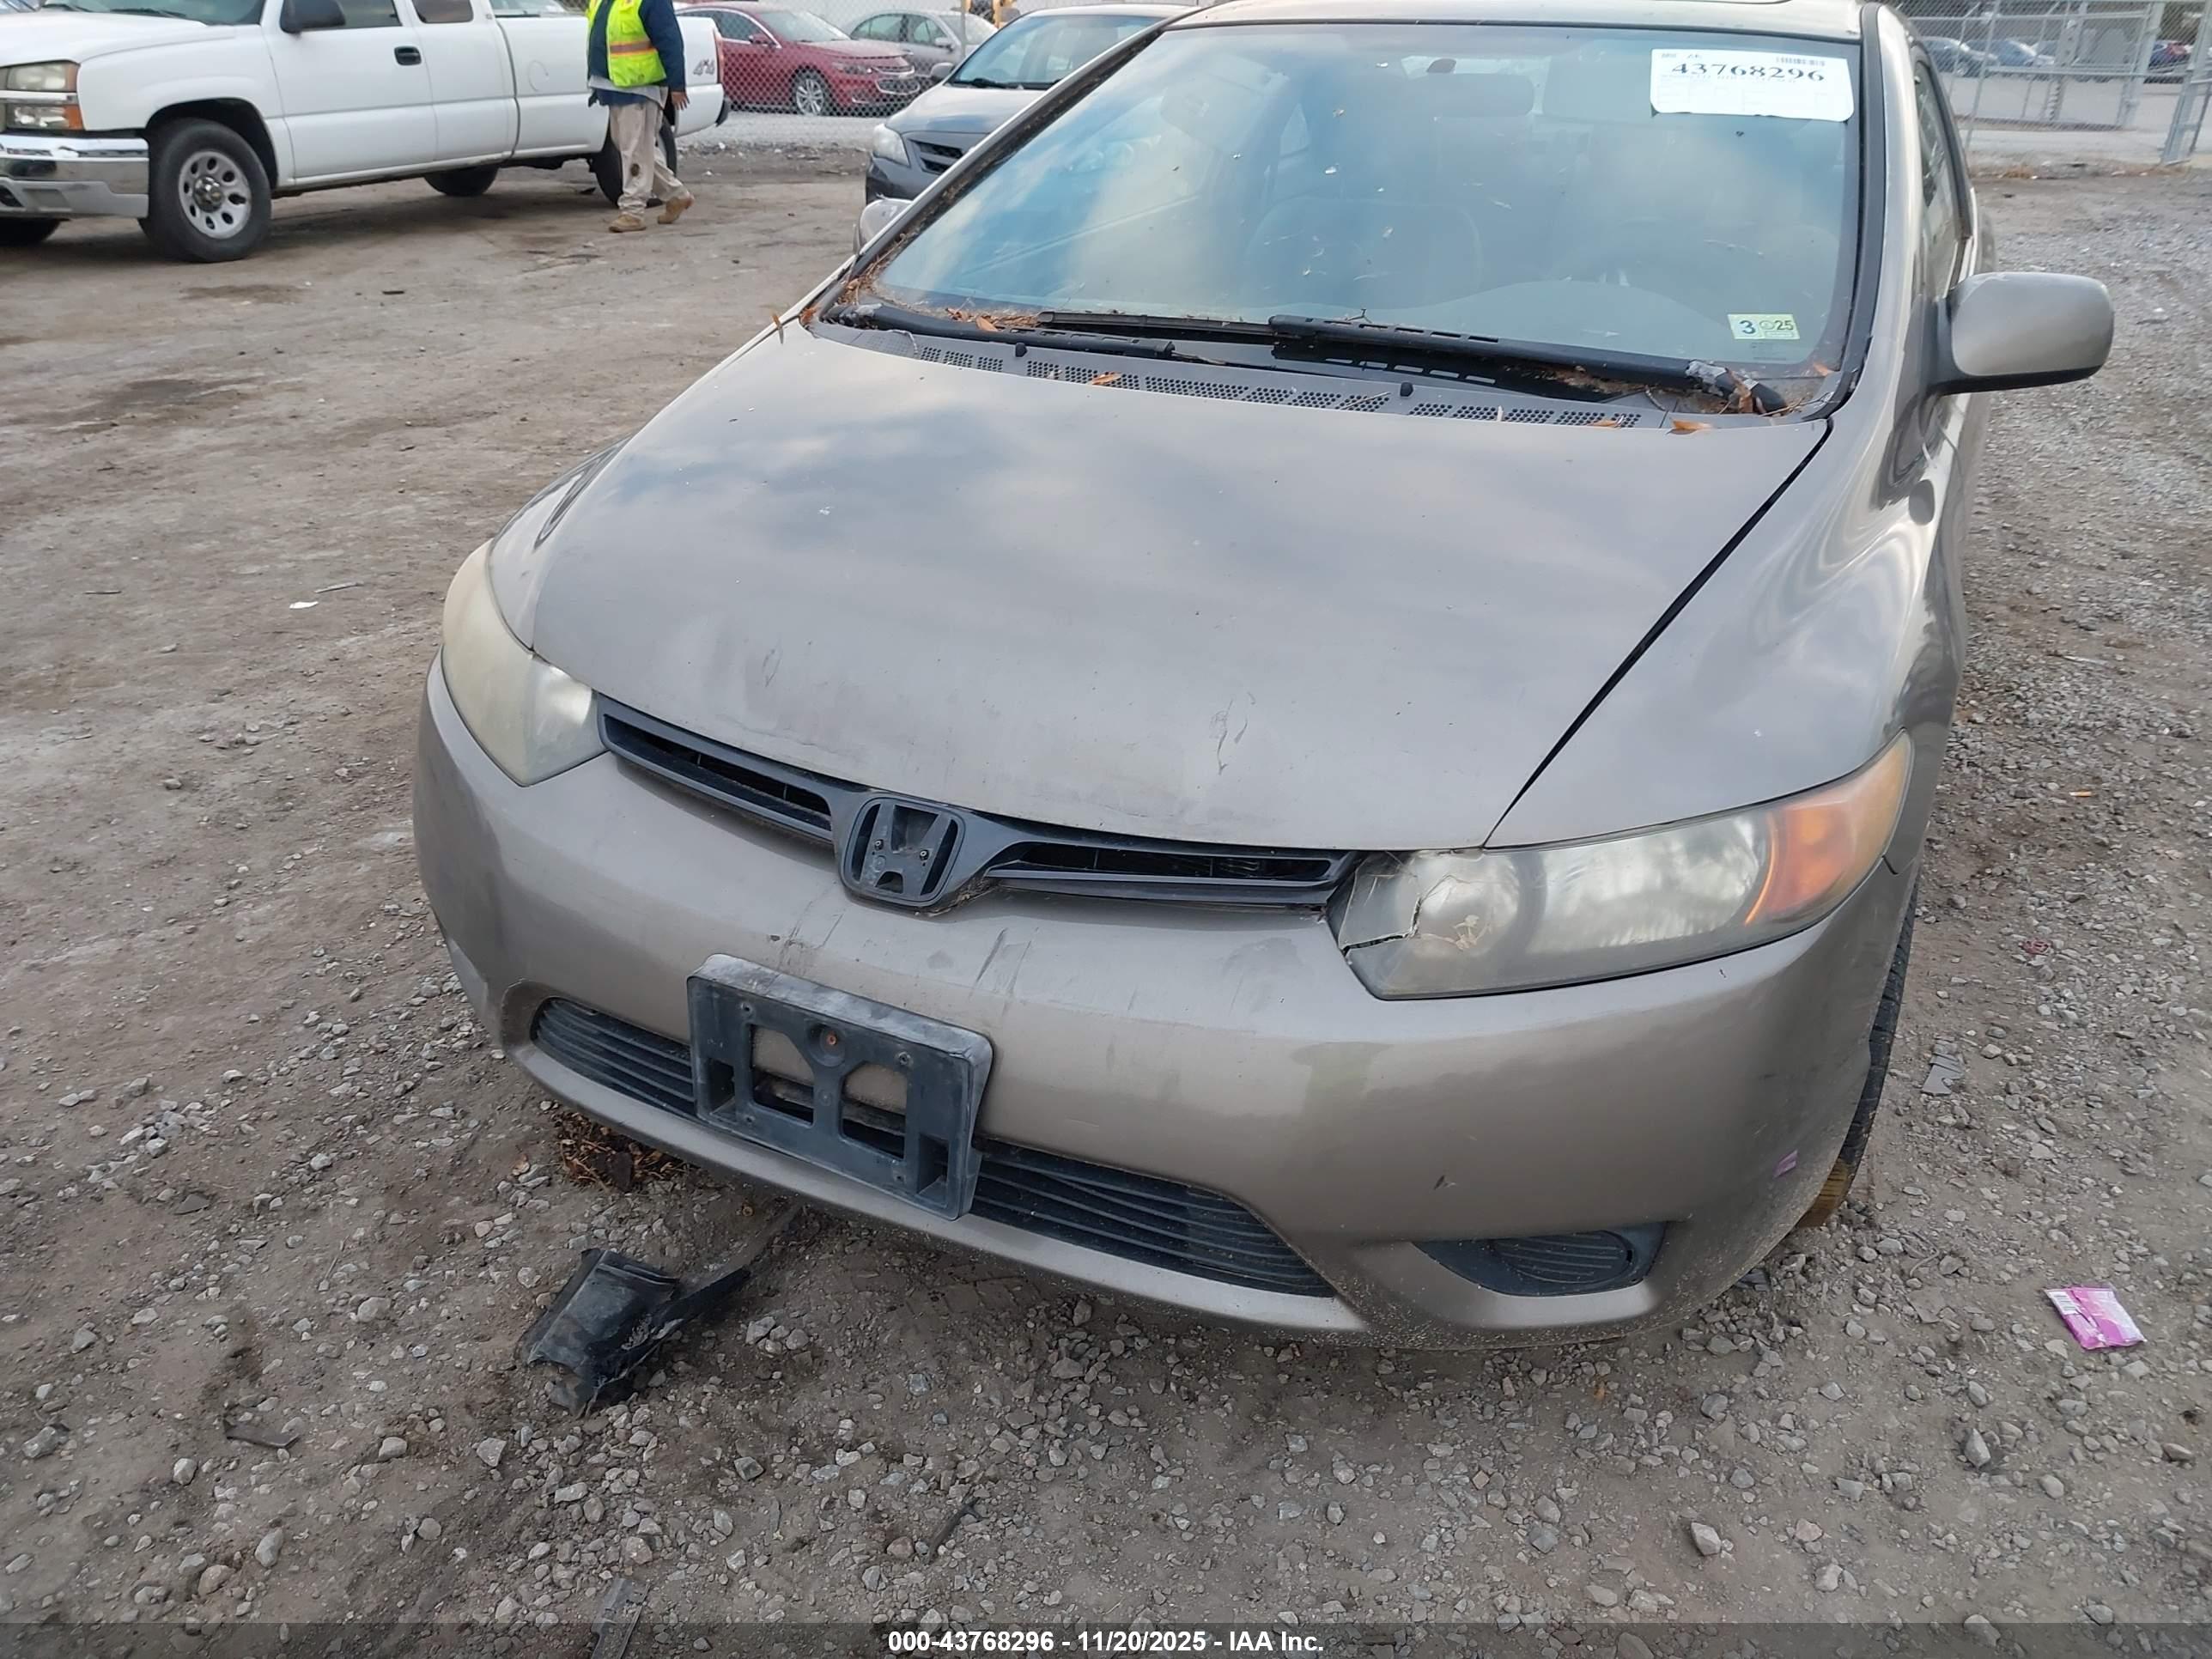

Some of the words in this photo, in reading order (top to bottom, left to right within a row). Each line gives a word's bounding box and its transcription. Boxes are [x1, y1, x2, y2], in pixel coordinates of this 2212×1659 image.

[1671, 62, 1825, 82] 43768296
[1739, 319, 1756, 335] 3
[1774, 319, 1794, 331] 25
